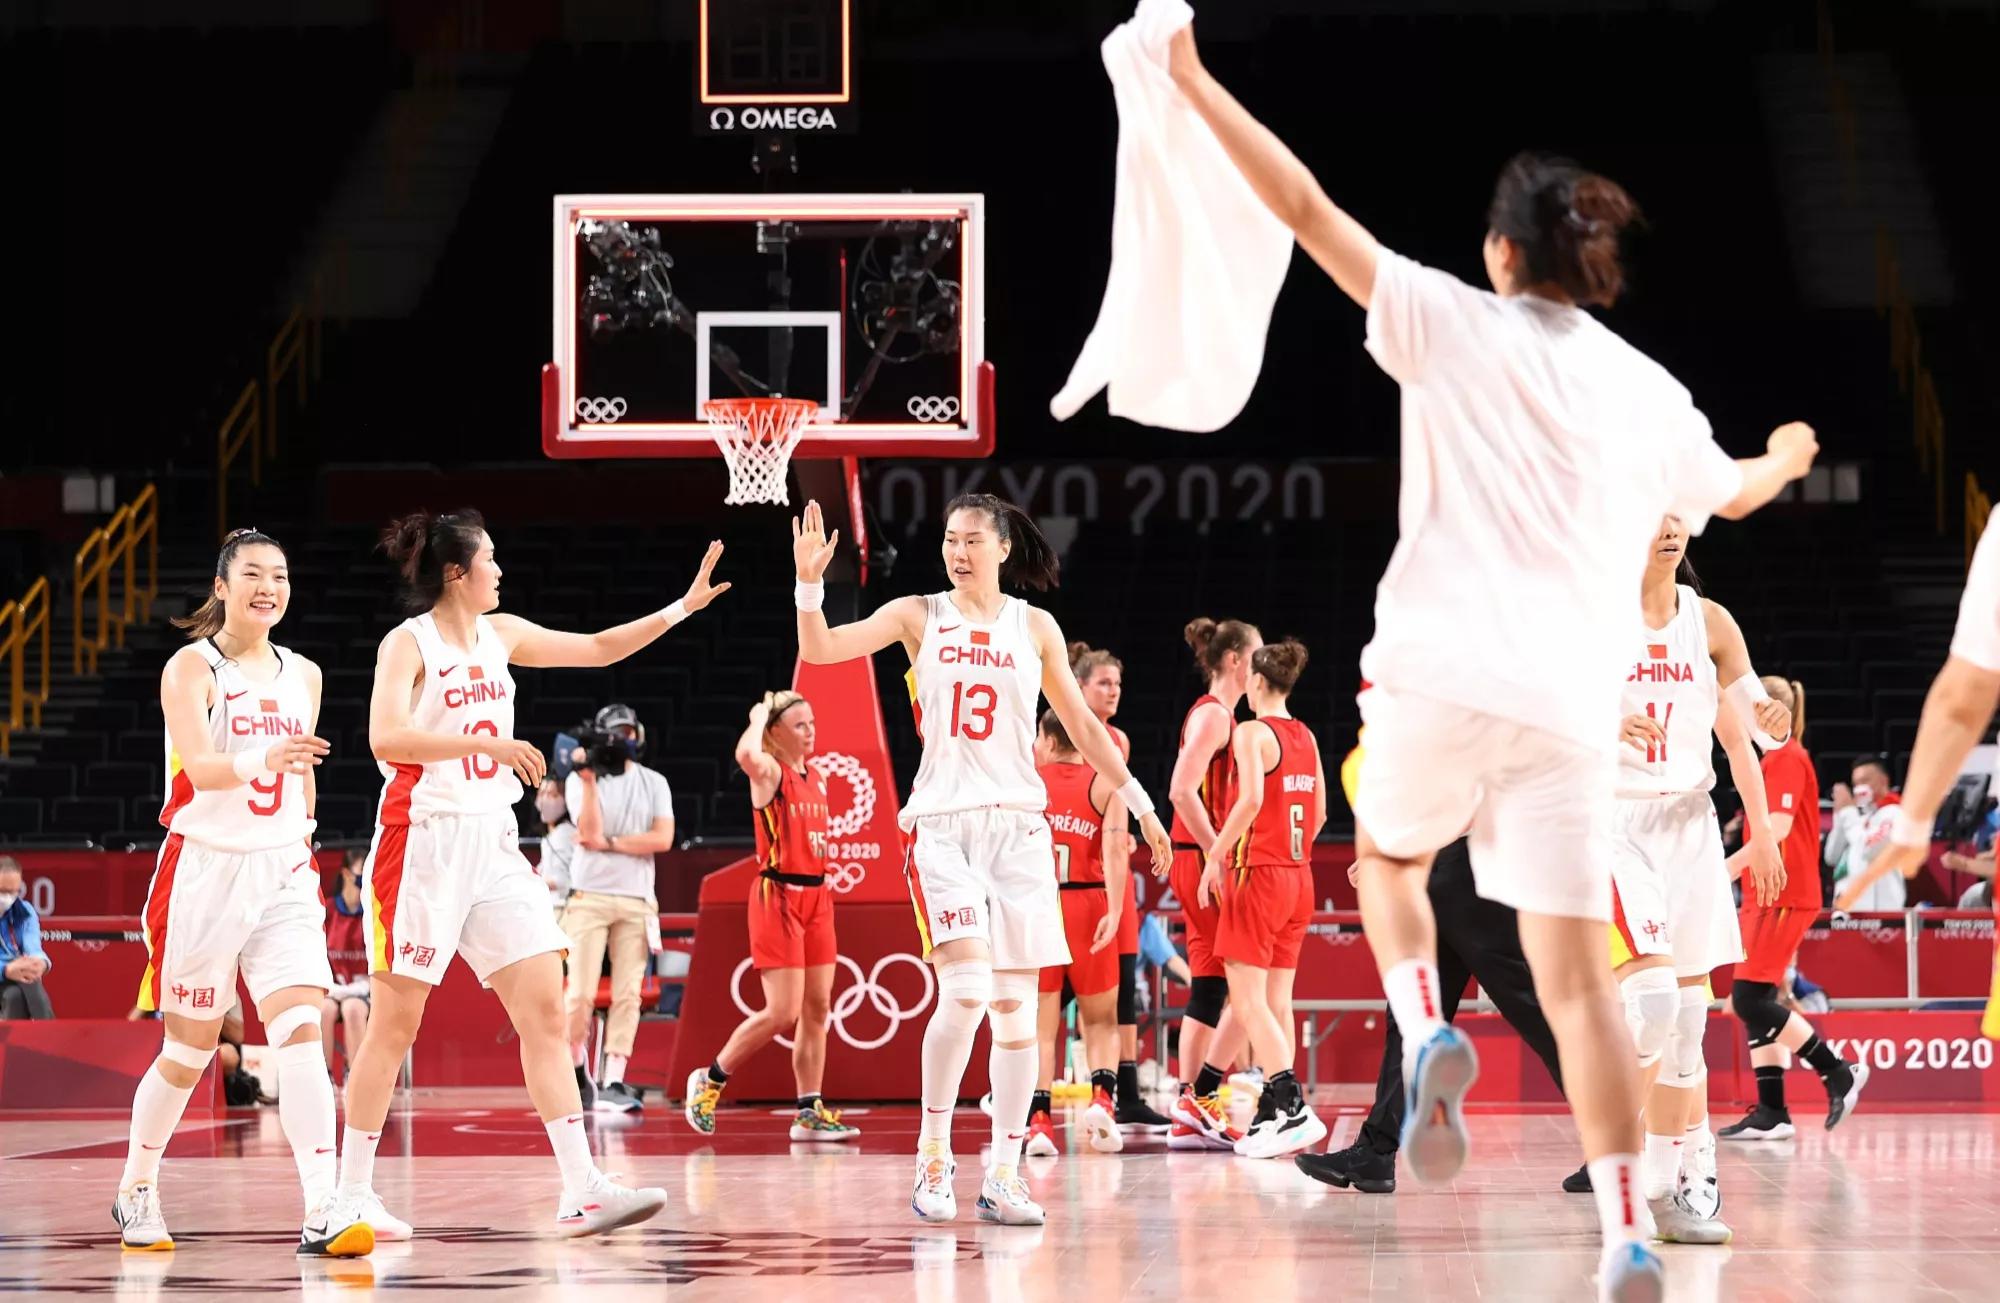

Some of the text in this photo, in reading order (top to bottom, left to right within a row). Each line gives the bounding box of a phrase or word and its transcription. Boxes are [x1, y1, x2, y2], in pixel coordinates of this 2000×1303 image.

[740, 107, 837, 130] OMEGA
[938, 646, 1016, 670] CHINA
[443, 680, 507, 709] CHINA
[950, 681, 998, 741] 13
[231, 715, 304, 736] CHINA
[461, 719, 499, 781] 10
[1289, 804, 1304, 861] 6
[841, 842, 881, 859] 2020
[938, 906, 978, 931] 中国
[399, 940, 436, 969] 中国
[171, 983, 215, 1009] 中国
[1903, 1038, 1994, 1070] 2020
